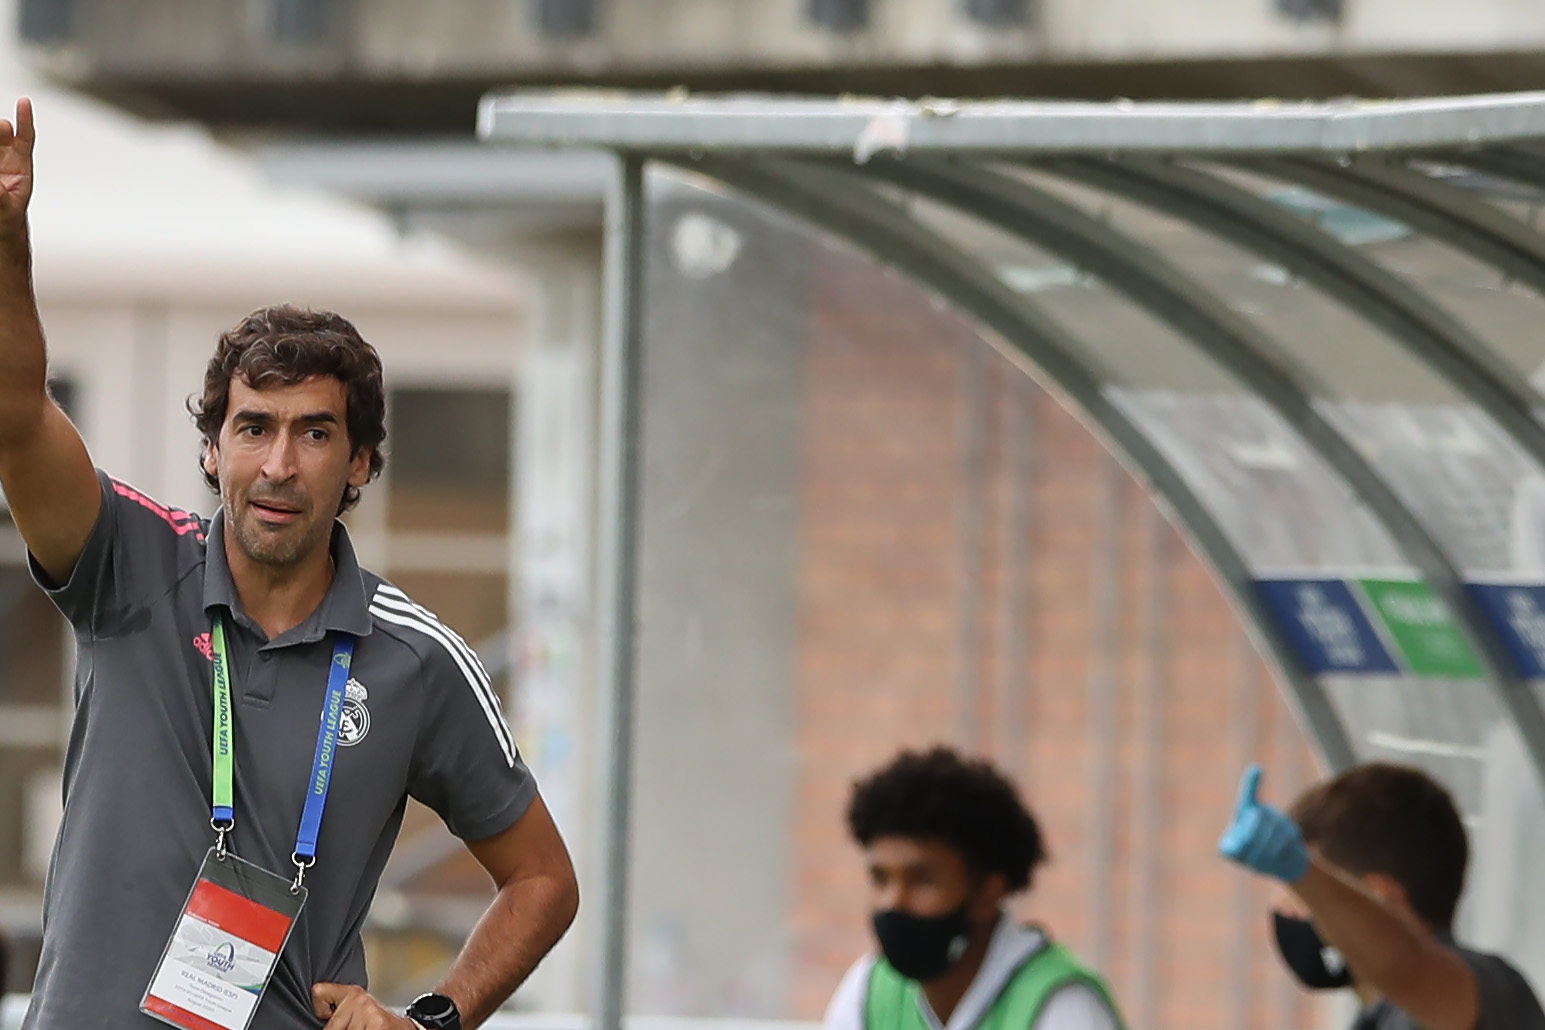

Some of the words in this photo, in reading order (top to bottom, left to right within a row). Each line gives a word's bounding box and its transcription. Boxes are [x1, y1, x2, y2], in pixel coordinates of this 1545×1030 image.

[214, 652, 226, 690] LEAGUE
[219, 692, 229, 728] YOUTH
[327, 690, 342, 730] LEAGUE
[219, 730, 228, 755] UEFA
[320, 731, 334, 768] YOUTH
[314, 769, 327, 795] UEFA
[207, 952, 235, 971] YOUTH
[180, 970, 196, 981] REAL
[196, 977, 223, 992] MADRID
